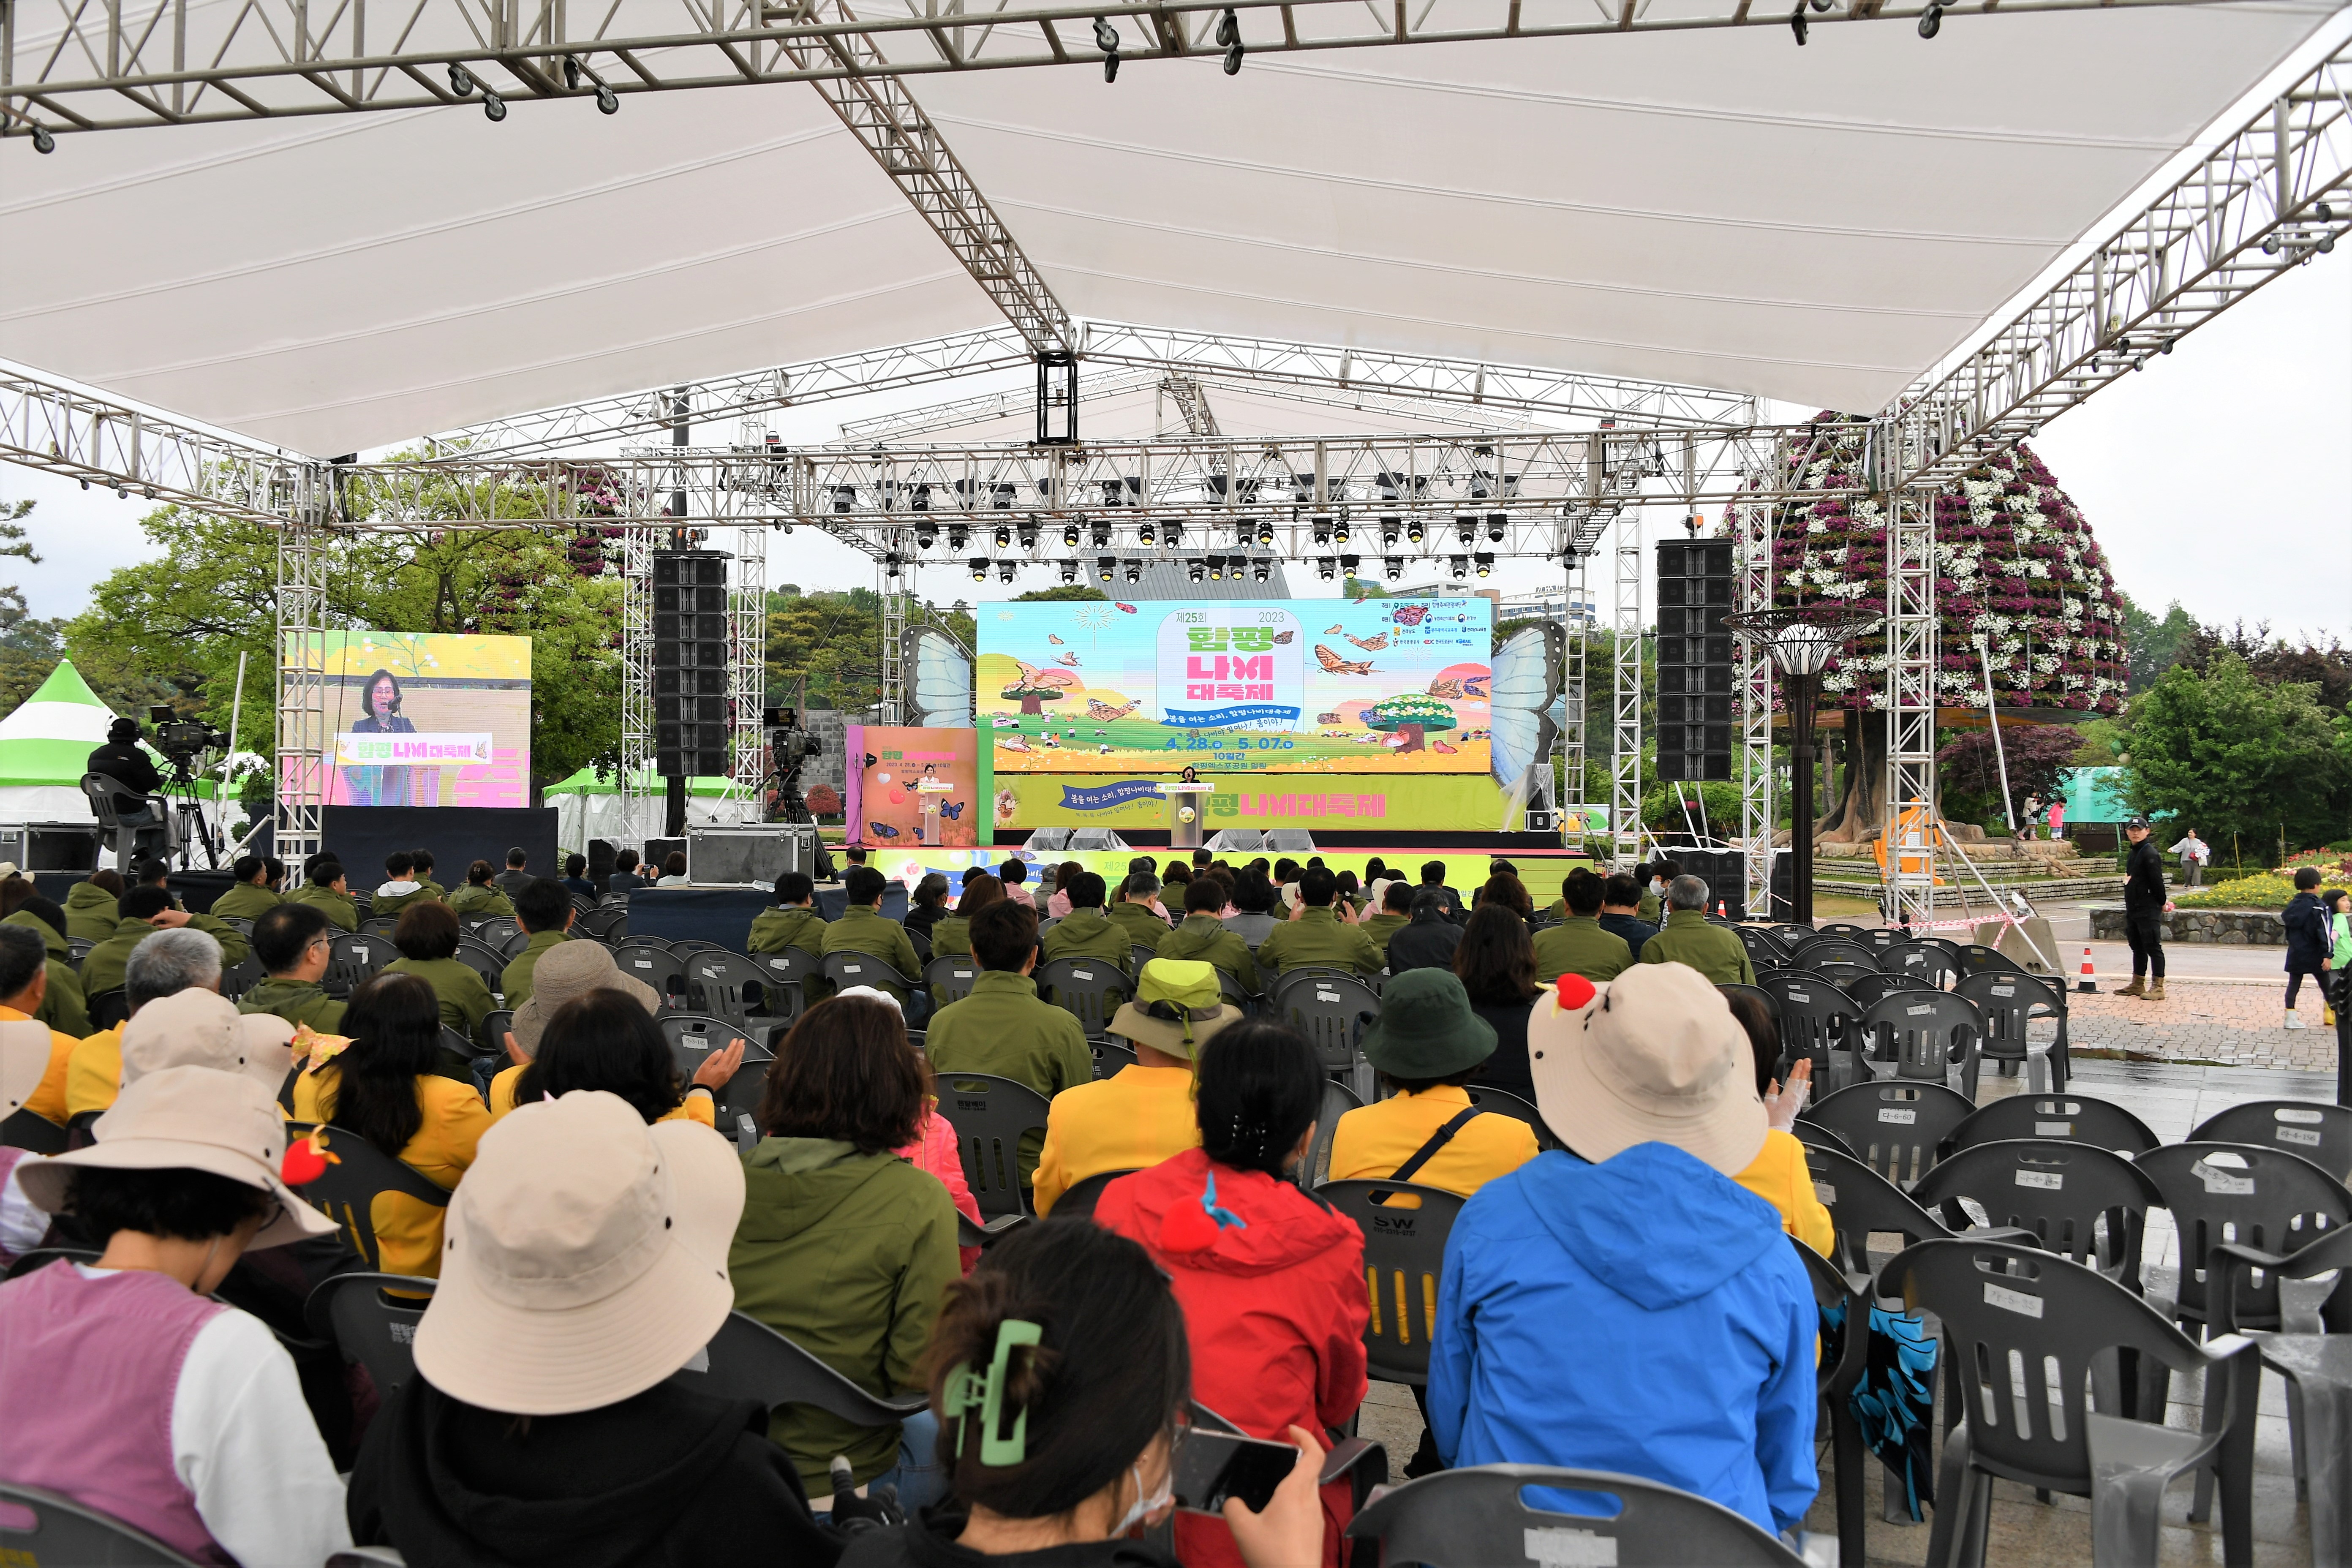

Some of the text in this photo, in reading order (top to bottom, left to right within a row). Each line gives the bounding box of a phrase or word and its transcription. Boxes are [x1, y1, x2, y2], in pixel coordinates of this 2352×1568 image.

[1176, 612, 1206, 623] 제25회
[1259, 612, 1285, 623] 2023
[1187, 627, 1274, 652] 함평
[1187, 656, 1273, 680] 나비
[1187, 684, 1273, 700] 대축제
[1188, 715, 1206, 723] 여는
[1208, 712, 1228, 722] 소리,
[1228, 708, 1292, 719] 함평나비대축제
[1204, 729, 1225, 738] 나비야
[1213, 752, 1245, 760] 10일간
[1071, 793, 1085, 805] 봄을
[1086, 795, 1100, 804] 여는
[1101, 791, 1117, 802] 소리,
